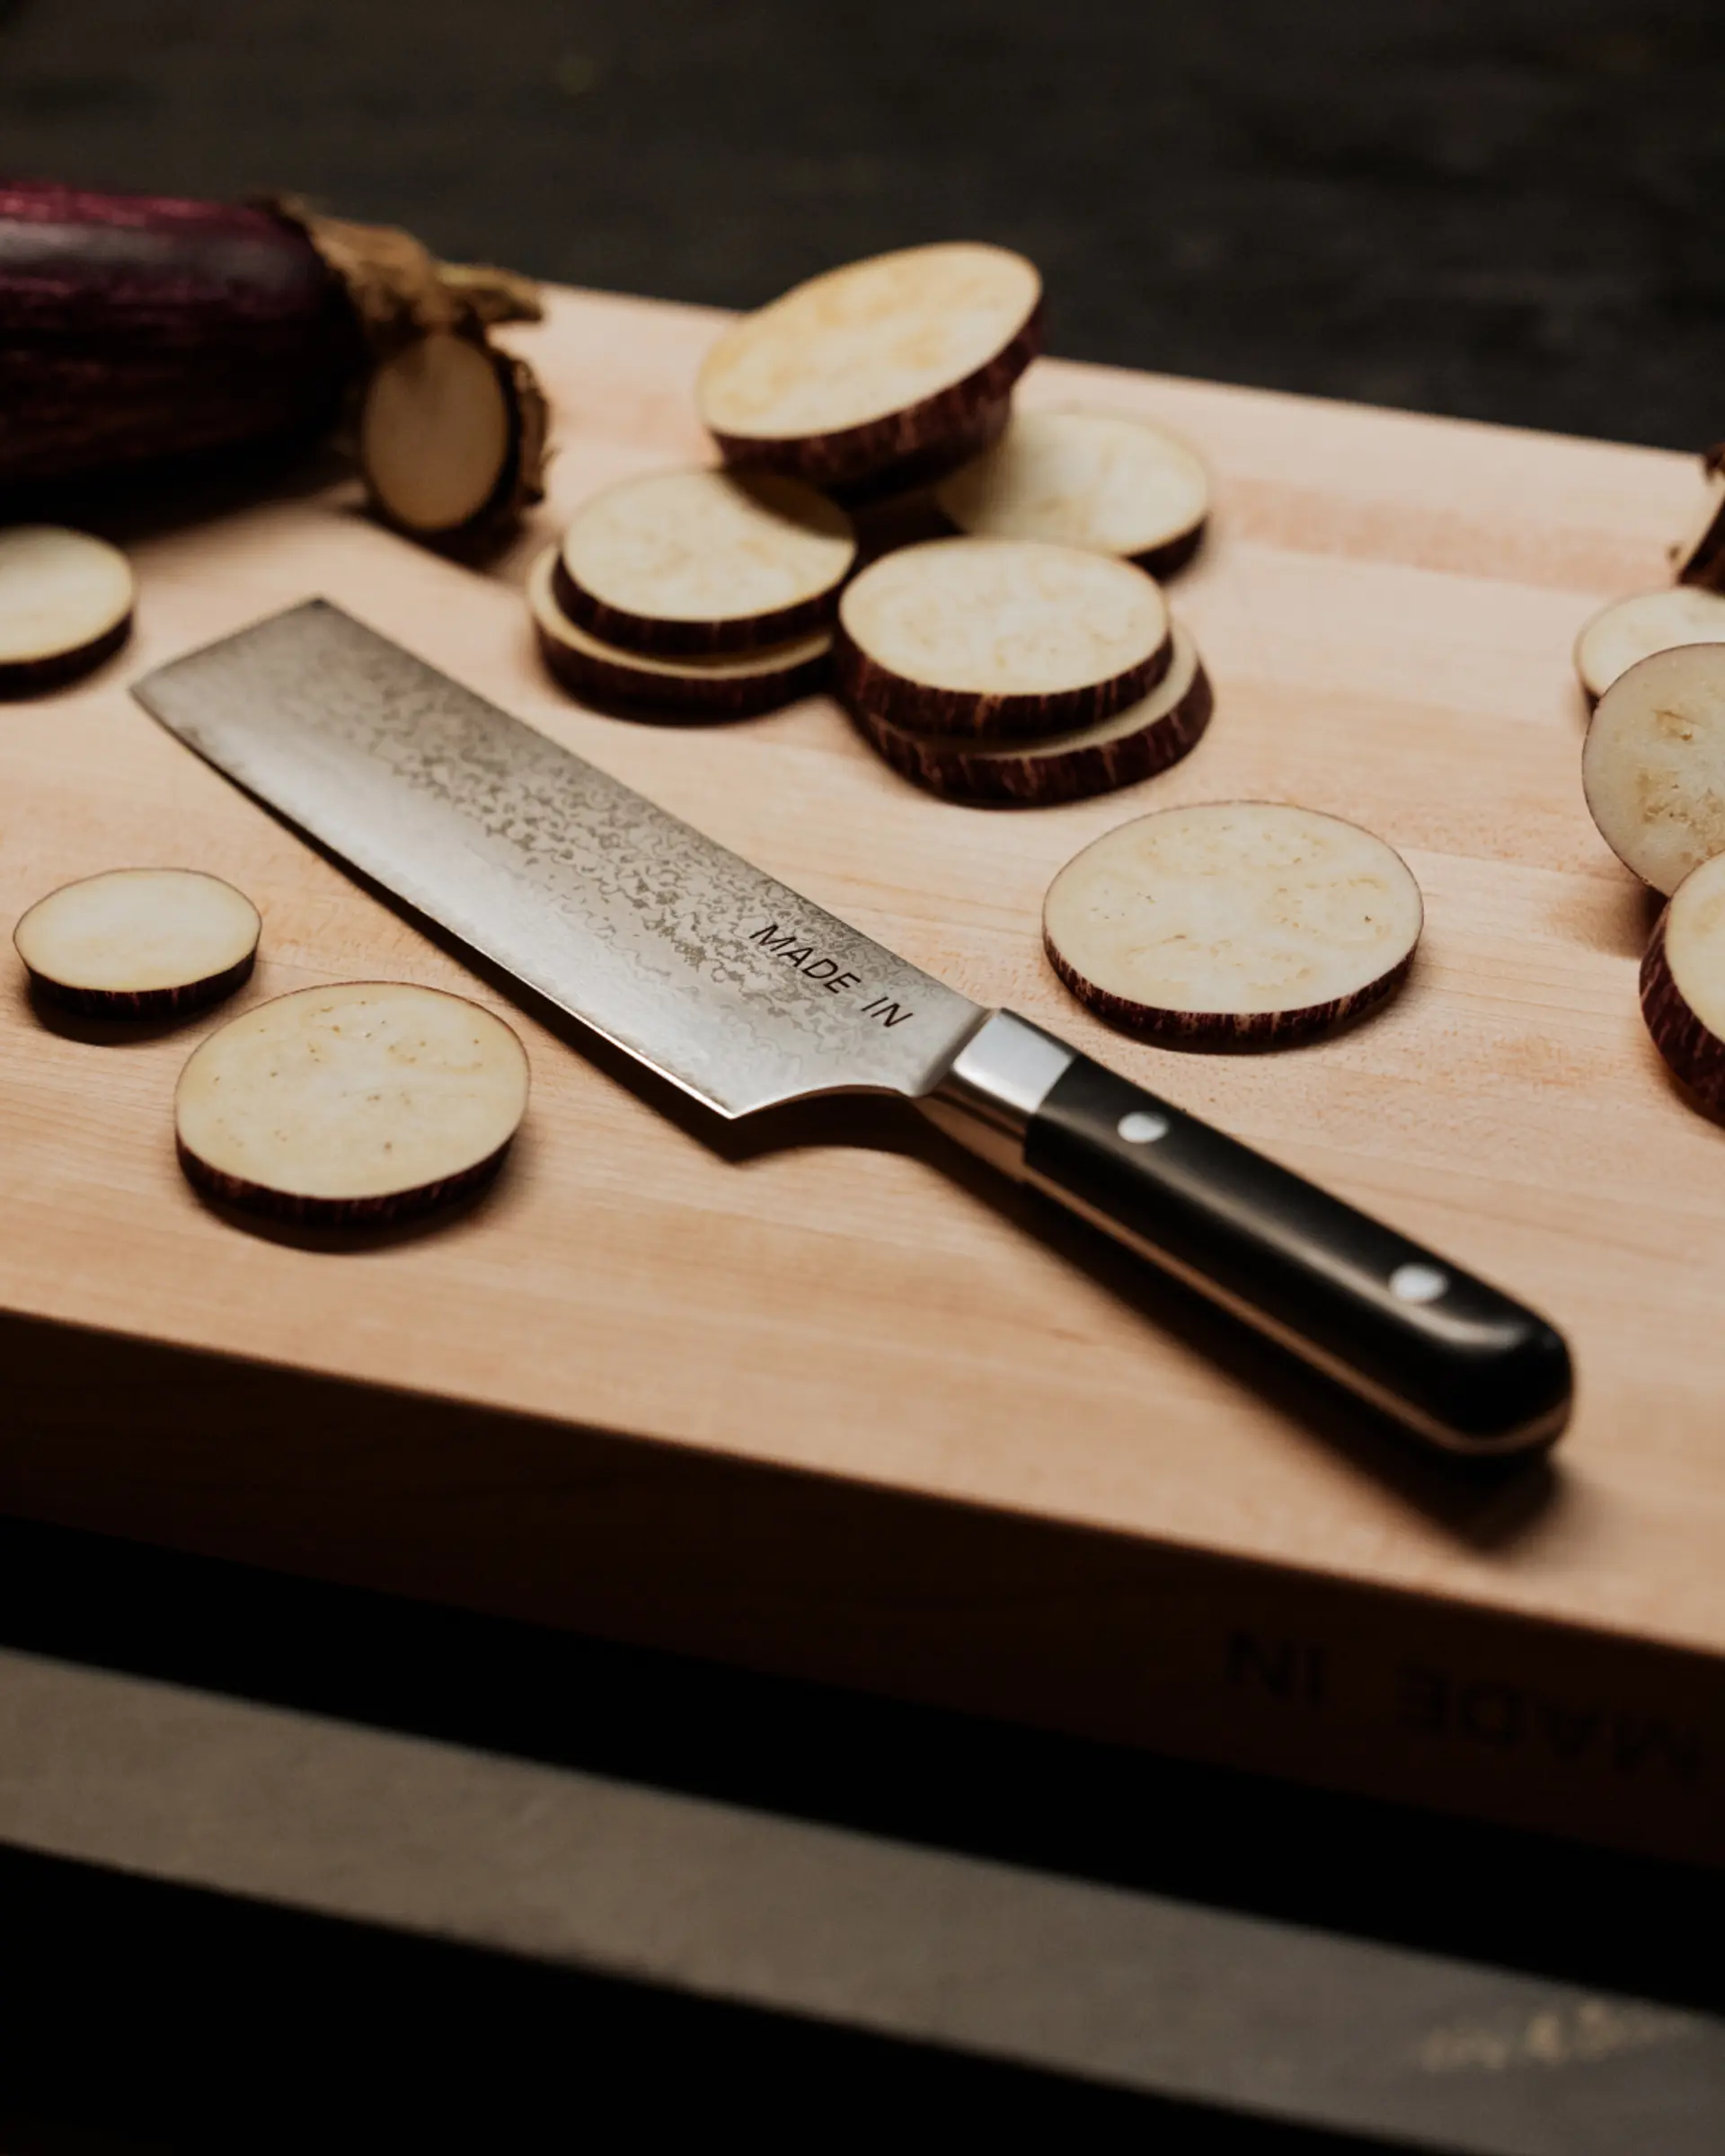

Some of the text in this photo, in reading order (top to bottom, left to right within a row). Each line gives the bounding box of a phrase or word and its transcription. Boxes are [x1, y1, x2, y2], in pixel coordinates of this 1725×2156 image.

[748, 923, 915, 1028] MADE IN
[1225, 1630, 1704, 1784] MADE IN
